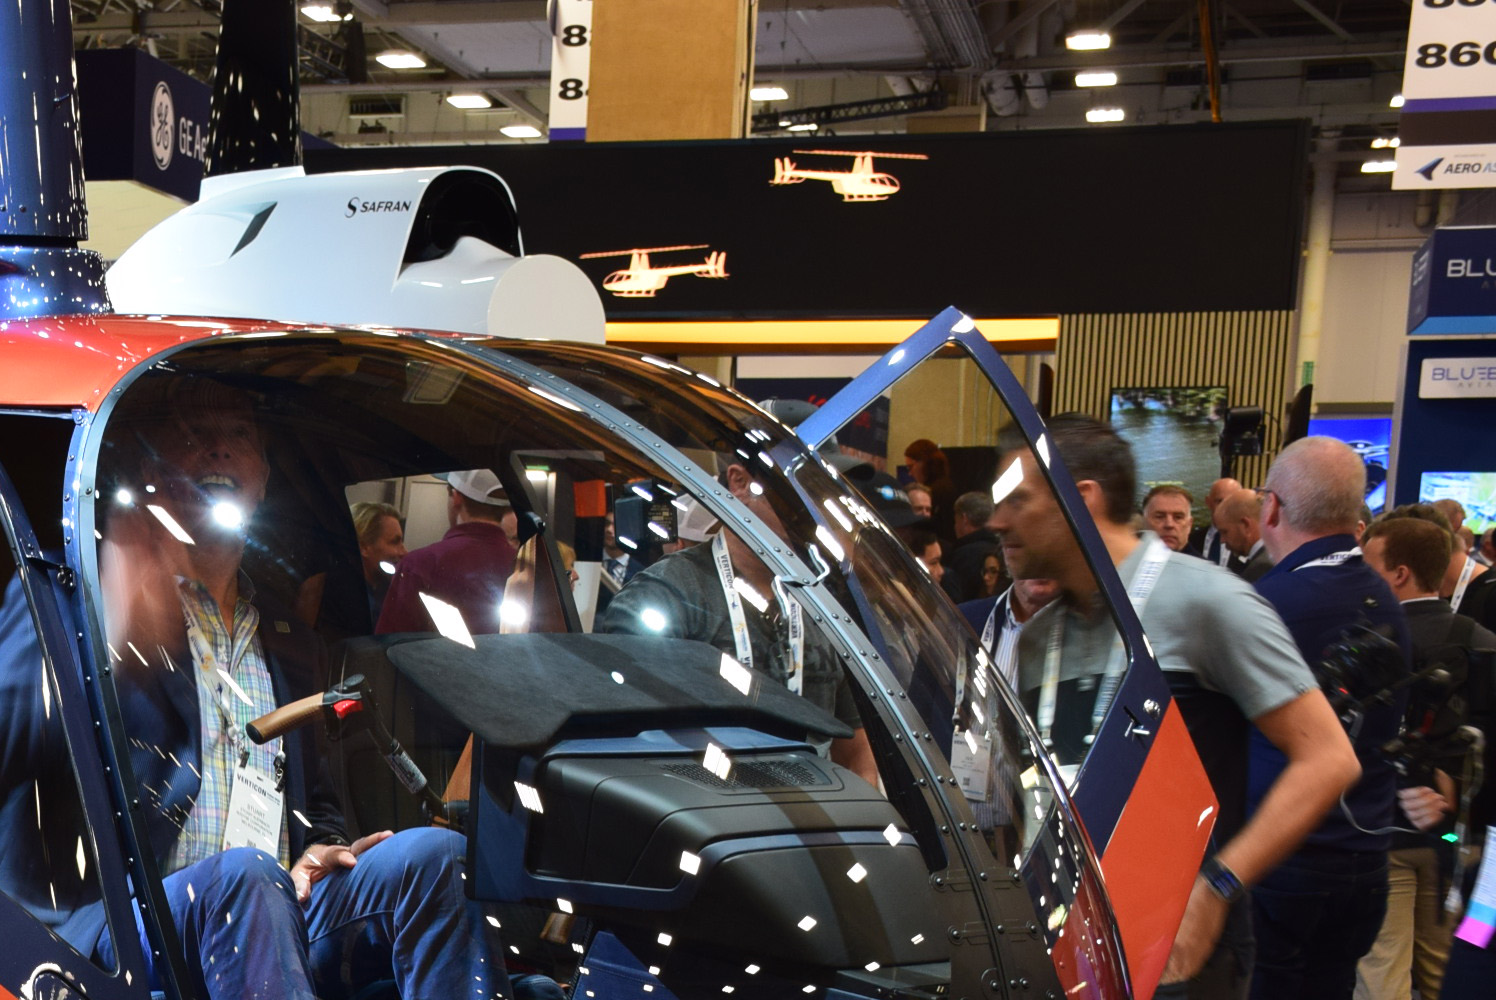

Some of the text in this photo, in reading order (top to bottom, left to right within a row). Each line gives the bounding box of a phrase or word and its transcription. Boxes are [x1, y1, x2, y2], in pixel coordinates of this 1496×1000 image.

[179, 116, 194, 154] GE
[1444, 163, 1481, 174] AERO
[360, 200, 412, 213] SAFRAN
